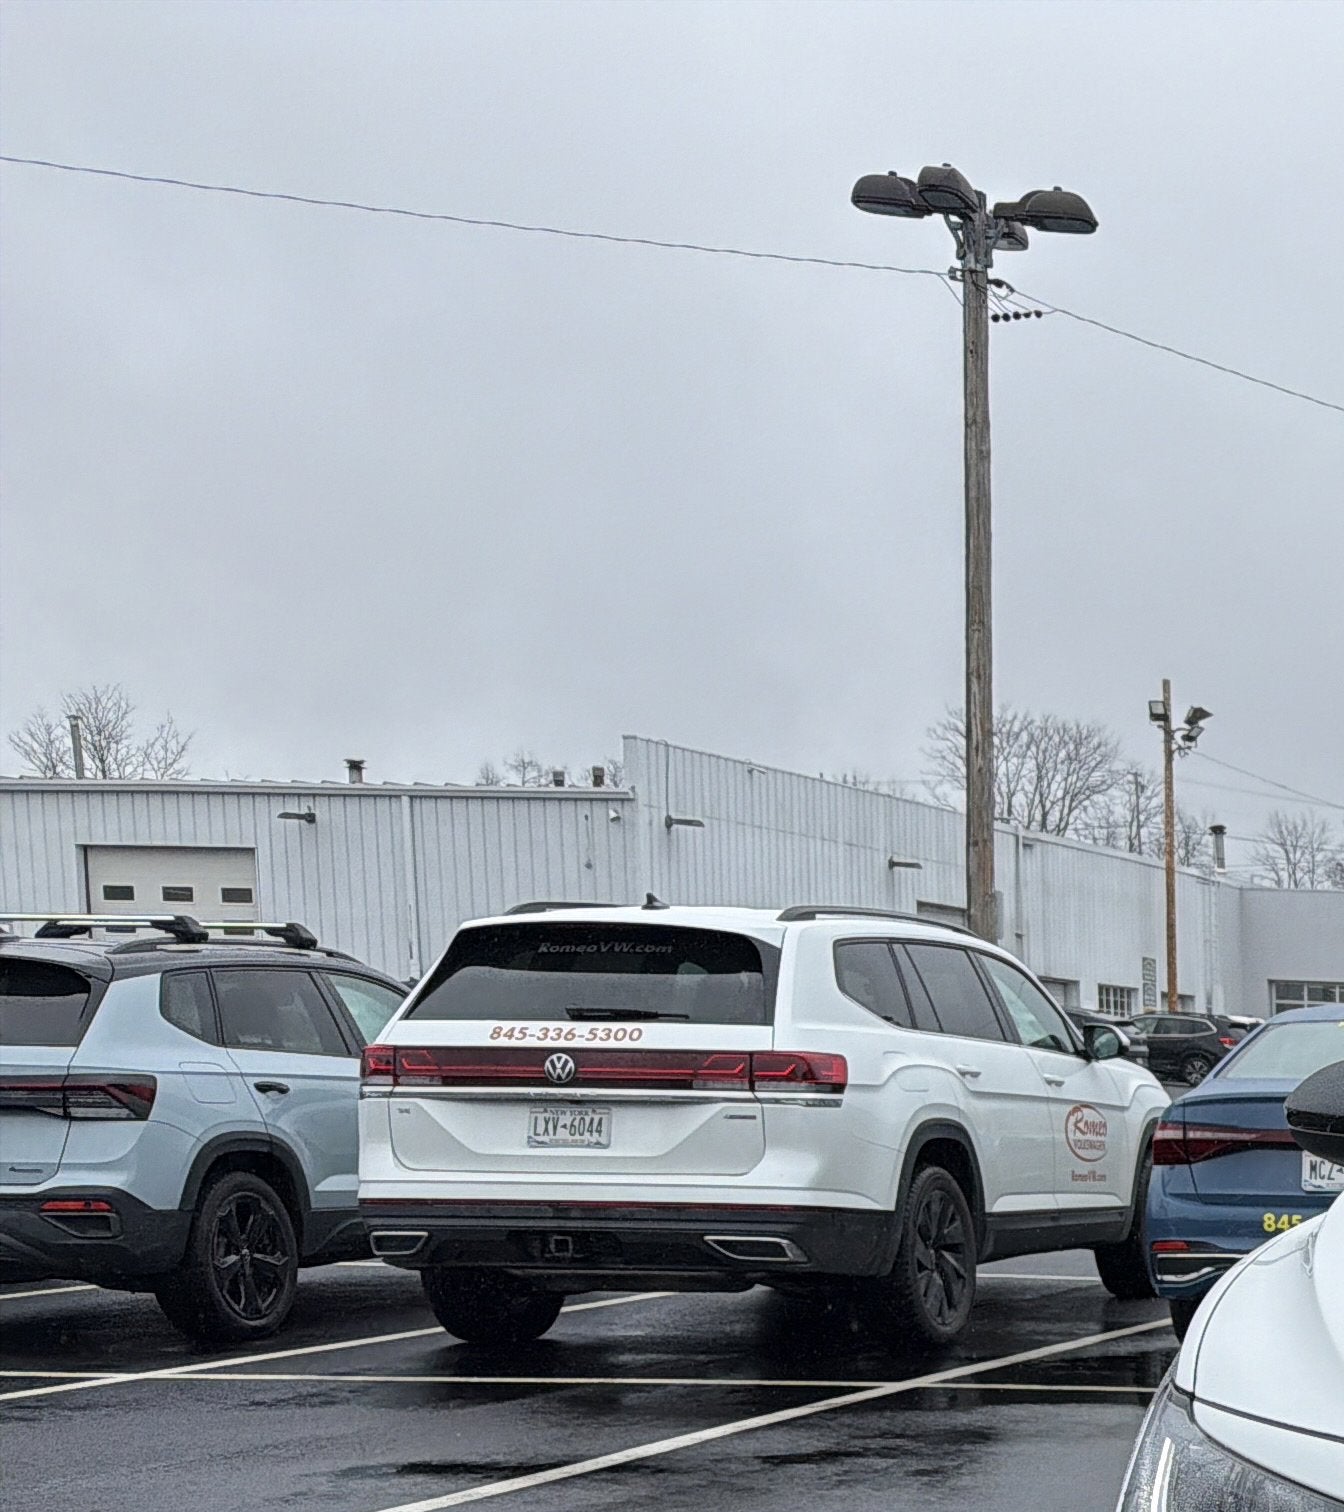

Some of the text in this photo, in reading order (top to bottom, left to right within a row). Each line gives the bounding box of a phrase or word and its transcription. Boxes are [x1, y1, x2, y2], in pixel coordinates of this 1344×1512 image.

[537, 942, 672, 954] RomeoVW.com
[490, 1026, 643, 1042] 845-336-5300
[533, 1116, 603, 1137] LXV 6044
[1071, 1106, 1108, 1137] Romeo
